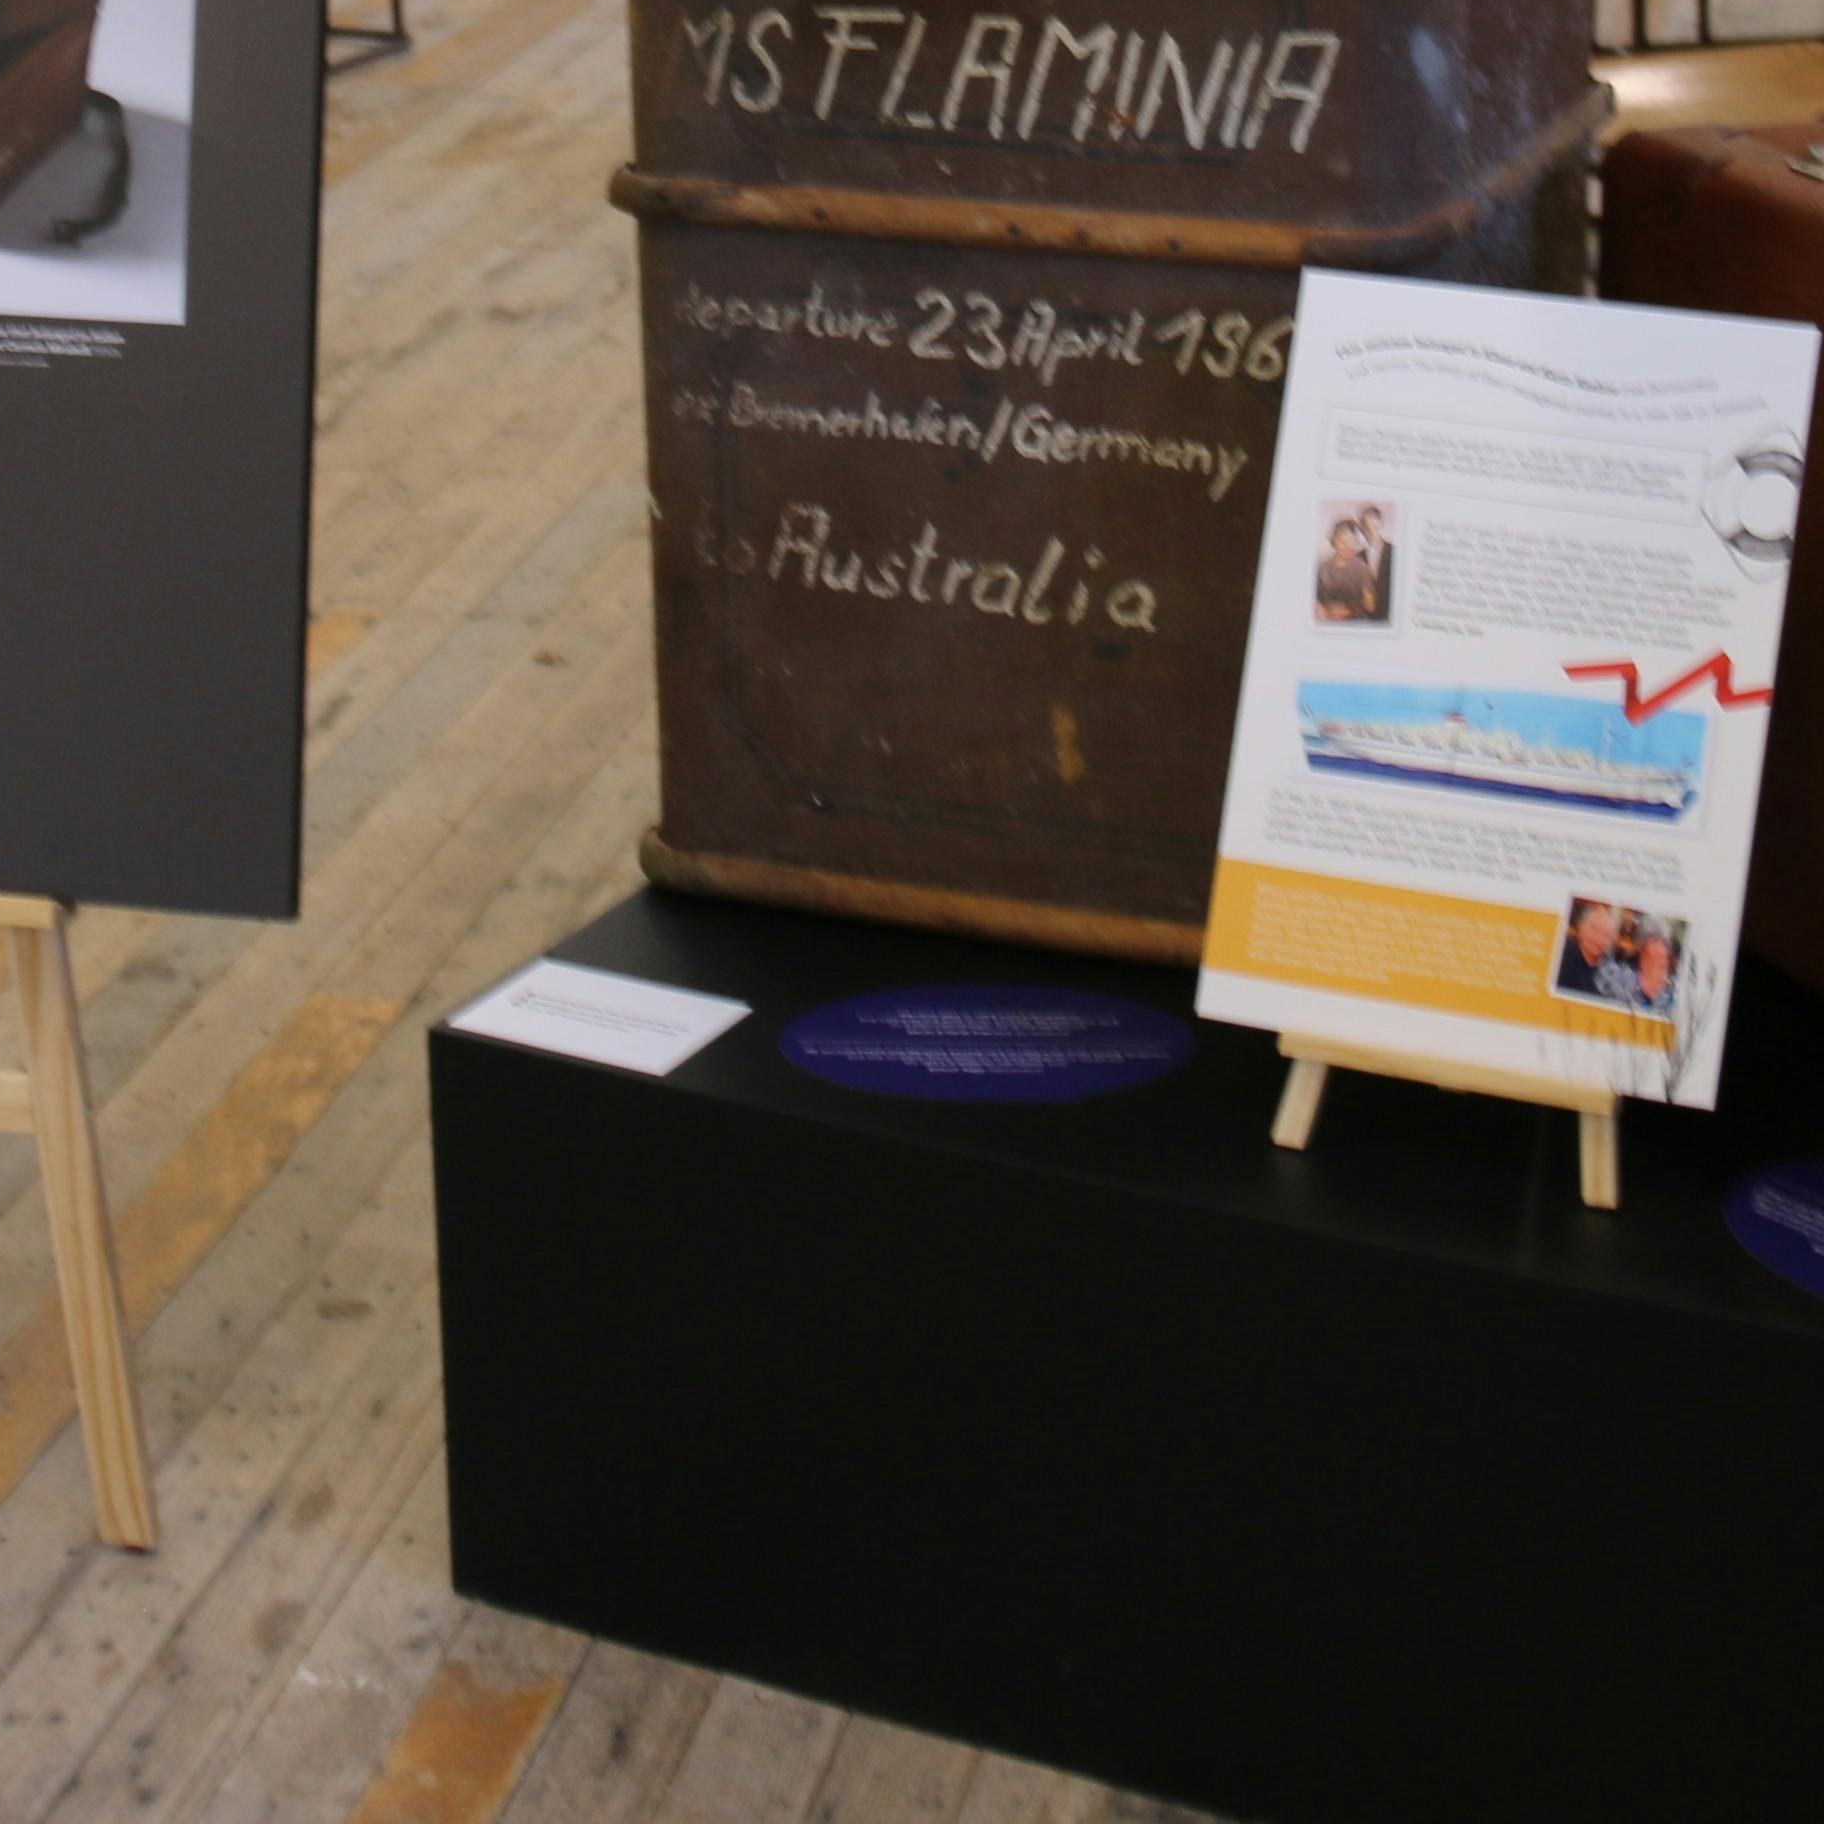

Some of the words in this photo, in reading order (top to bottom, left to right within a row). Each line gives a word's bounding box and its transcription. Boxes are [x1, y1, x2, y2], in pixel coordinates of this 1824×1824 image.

[813, 3, 1342, 155] FLAMINIA
[907, 287, 1008, 371] 23
[1009, 297, 1146, 388] April
[1152, 307, 1297, 383] 196
[767, 501, 1158, 634] Australia
